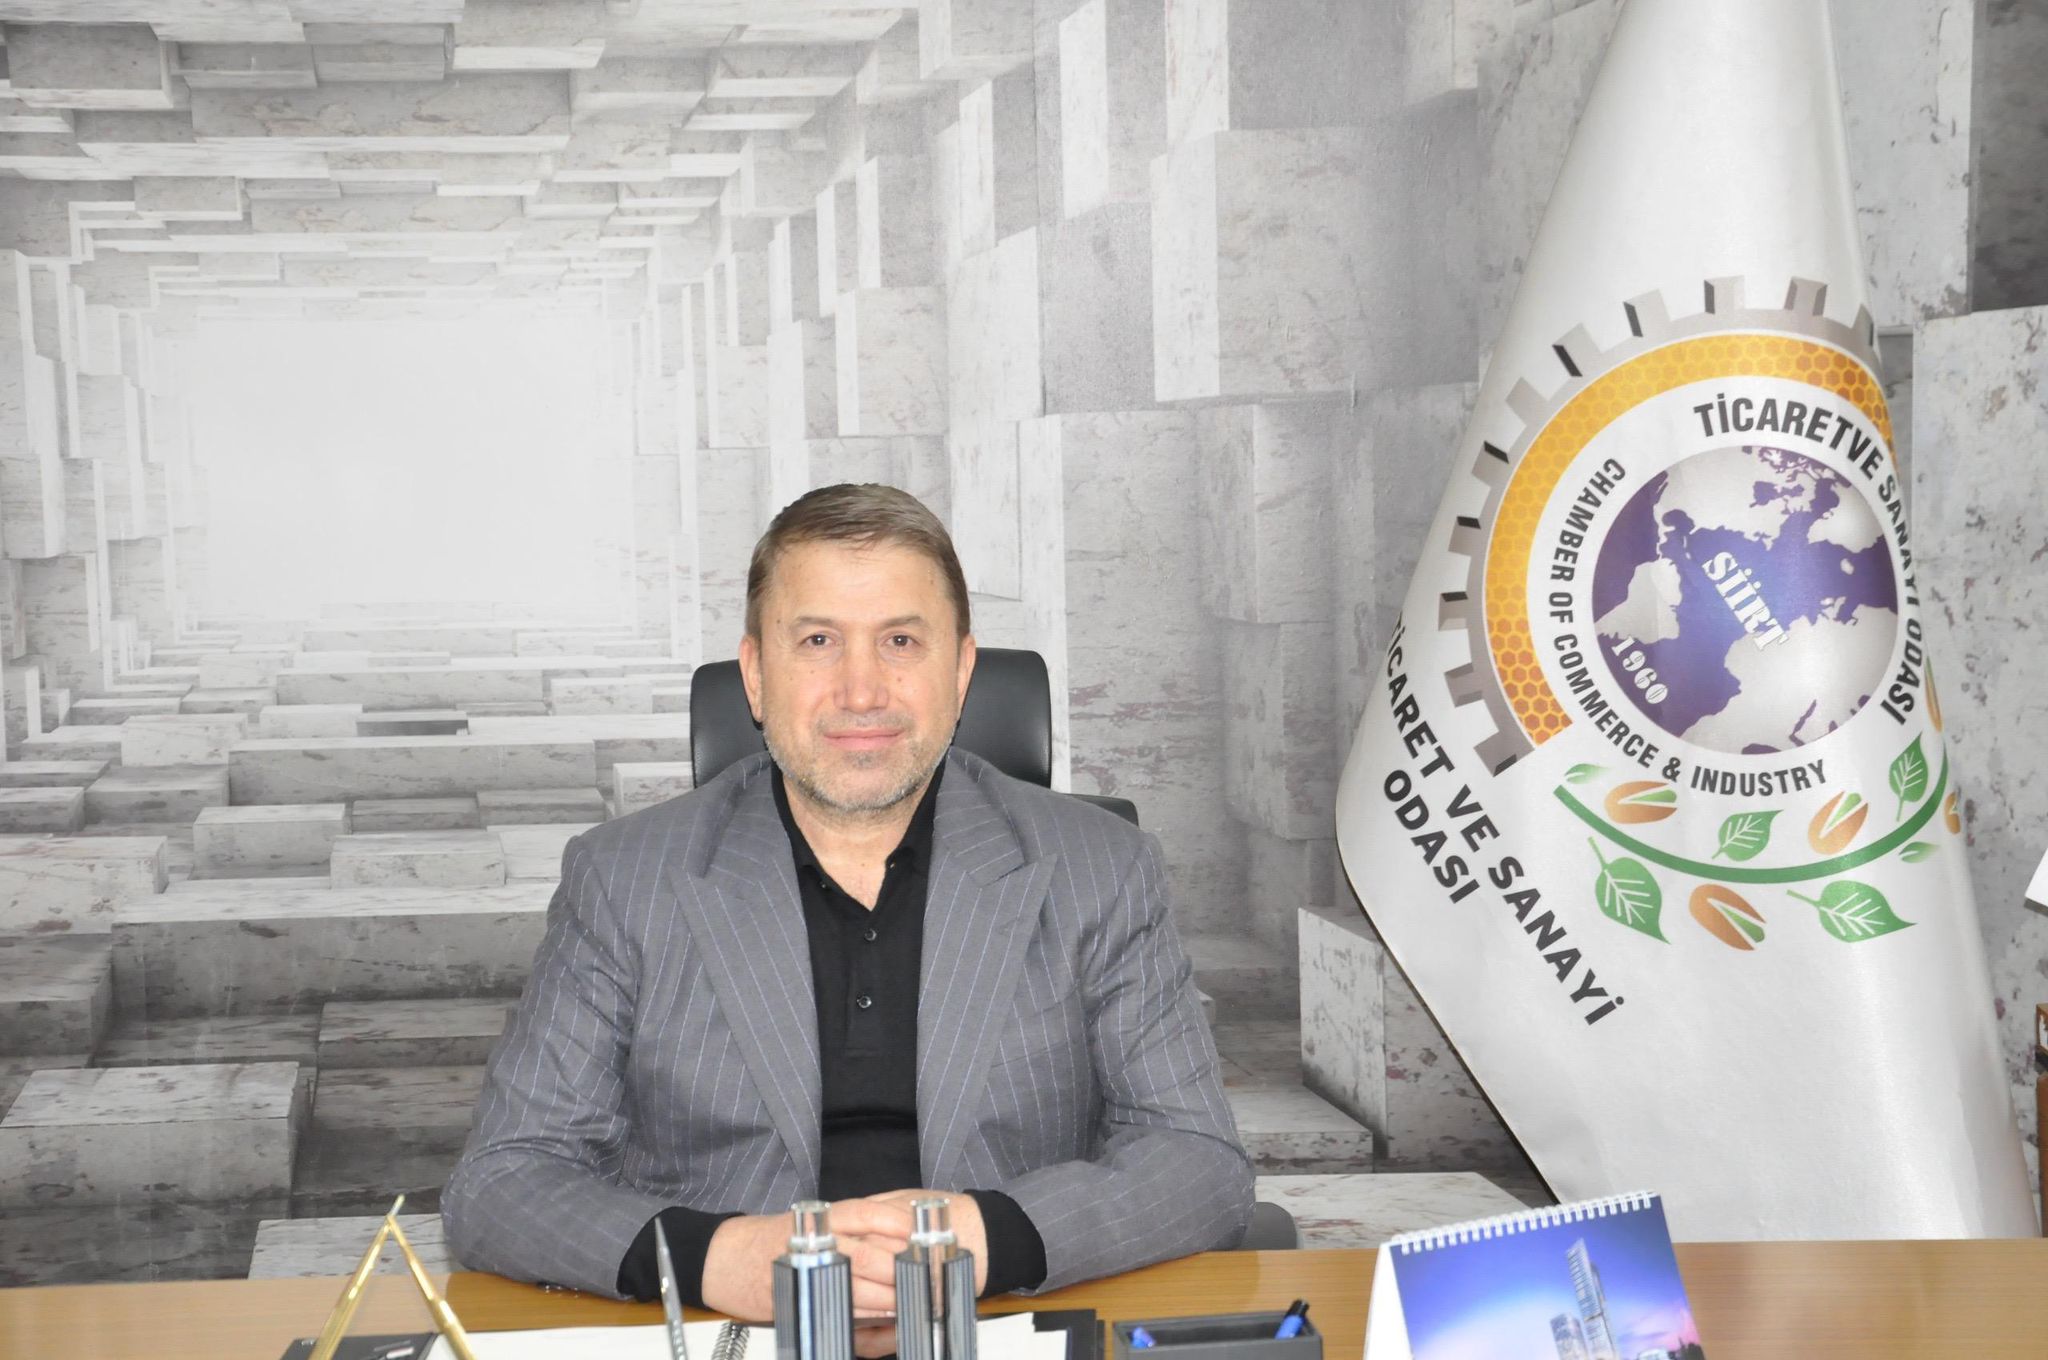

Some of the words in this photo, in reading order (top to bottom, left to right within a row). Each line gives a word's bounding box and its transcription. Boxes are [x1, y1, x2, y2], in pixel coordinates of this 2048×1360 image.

[1550, 458, 1626, 582] CHAMBER
[1549, 591, 1574, 627] OF
[1554, 633, 1659, 769] COMMERCE
[1611, 636, 1669, 704] 1960
[1880, 617, 1922, 725] ODASI
[1662, 756, 1682, 782] &
[1690, 759, 1827, 797] INDUSTRY
[1383, 769, 1480, 904] ODASI
[1445, 784, 1501, 852] VE
[1488, 856, 1625, 1026] SANAYİ
